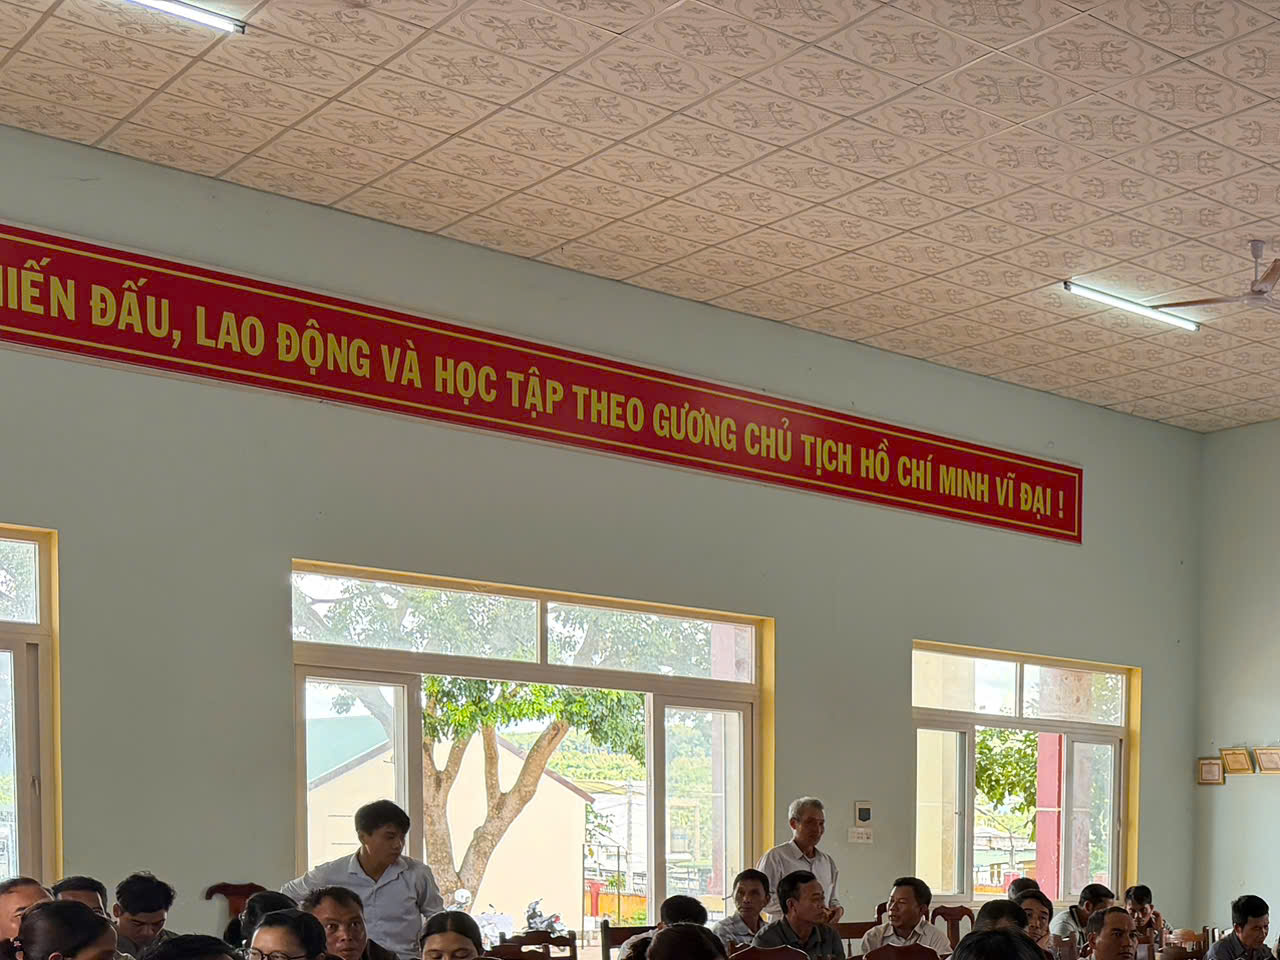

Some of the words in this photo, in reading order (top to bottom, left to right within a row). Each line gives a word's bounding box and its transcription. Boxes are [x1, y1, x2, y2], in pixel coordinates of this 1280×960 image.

[89, 277, 182, 349] ĐẤU,
[196, 305, 265, 357] LAO
[276, 318, 370, 379] ĐỘNG
[380, 339, 422, 389] VÀ
[435, 356, 497, 406] HỌC
[506, 366, 564, 419] TẬP
[571, 384, 645, 433] THEO
[652, 401, 737, 452] GƯƠNG
[744, 416, 792, 462] CHỦ
[800, 433, 852, 476] TỊCH
[860, 438, 890, 482] HỒ
[897, 454, 933, 491] CHÍ
[939, 464, 989, 503] MINH
[995, 472, 1016, 508] VĨ
[1019, 482, 1052, 520] ĐẠI
